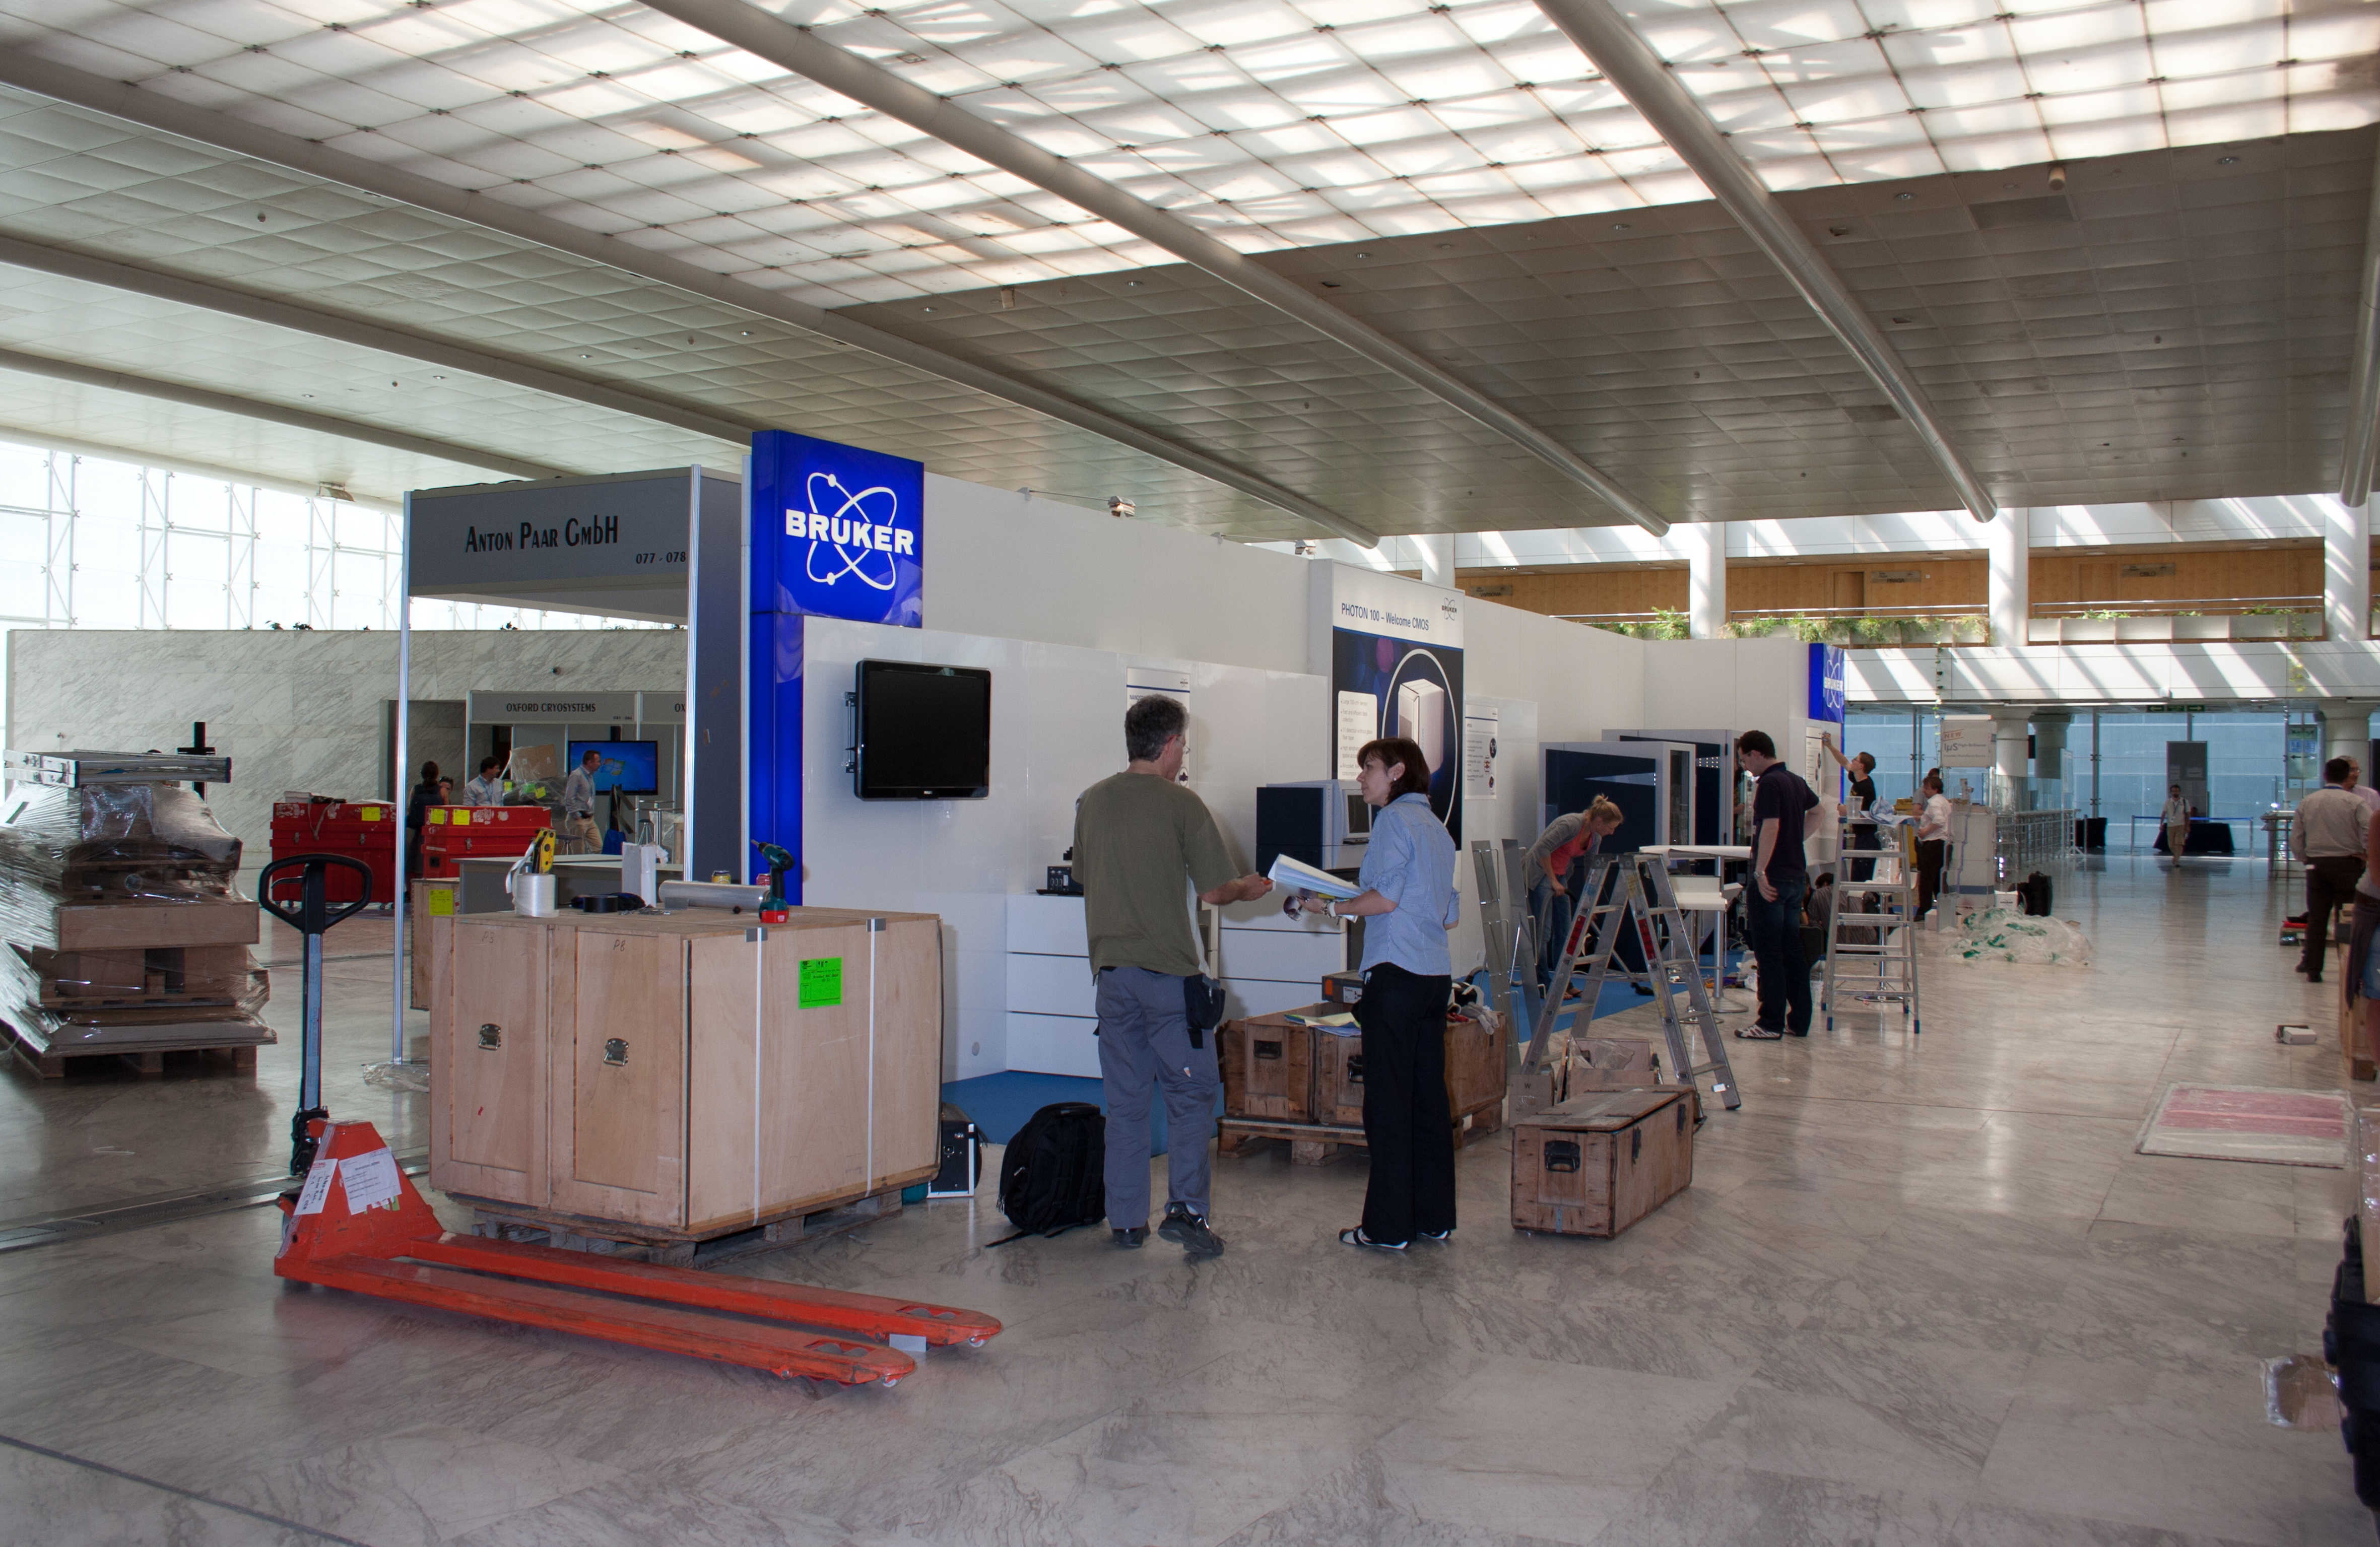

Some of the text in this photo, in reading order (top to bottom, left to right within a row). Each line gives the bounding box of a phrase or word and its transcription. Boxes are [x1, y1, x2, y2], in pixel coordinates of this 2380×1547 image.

[786, 509, 913, 556] BRUKER
[636, 553, 655, 564] 077
[666, 551, 686, 563] 078
[1441, 605, 1457, 613] BRUKER
[1342, 602, 1368, 620] PHOTON
[1370, 609, 1379, 621] 100
[1386, 612, 1411, 628] Welcome
[1412, 617, 1429, 631] CMOS
[506, 703, 597, 712] OXFORD CRYOSYSTEMS
